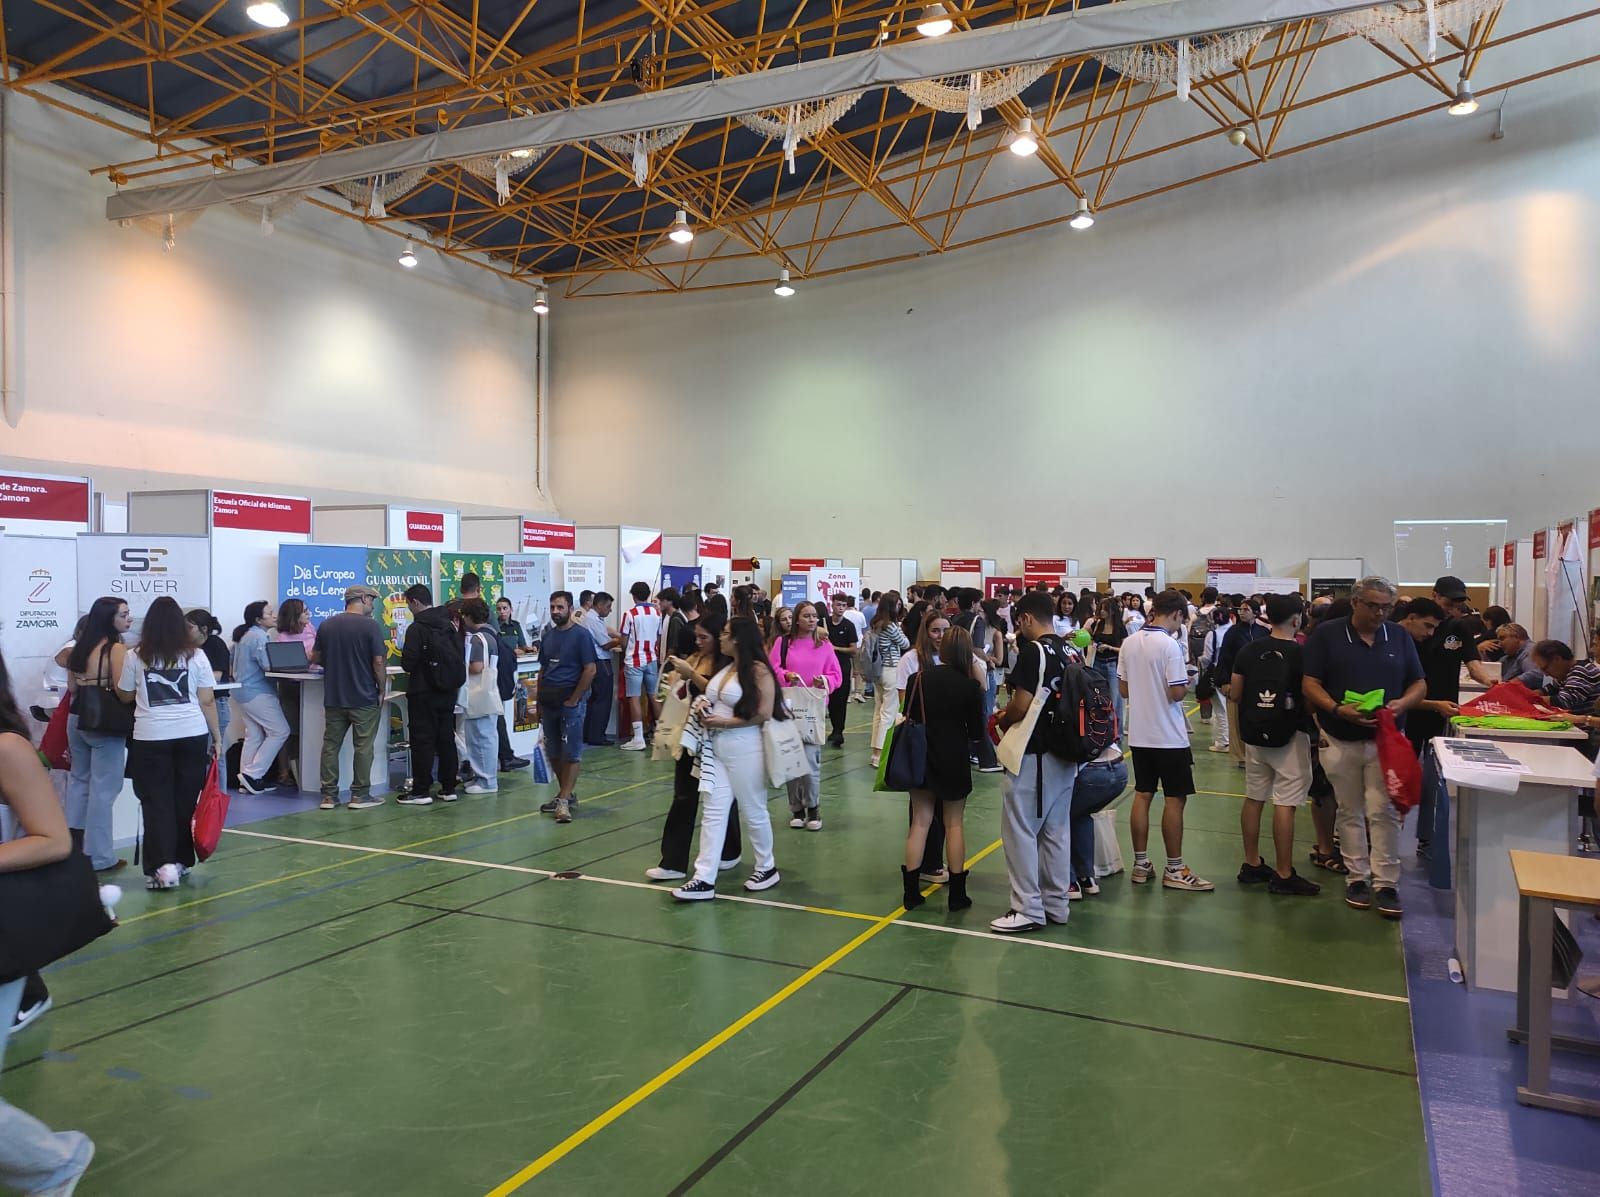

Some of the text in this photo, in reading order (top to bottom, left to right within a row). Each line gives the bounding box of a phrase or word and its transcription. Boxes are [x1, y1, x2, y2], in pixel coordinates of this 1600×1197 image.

[0, 482, 48, 494] de Zamora.
[214, 497, 238, 506] Escuela
[238, 499, 259, 508] Oficial
[214, 506, 239, 515] Zamora
[293, 564, 356, 584] Día Europeo
[366, 575, 430, 585] GUARDIA CIVIL
[833, 581, 853, 589] ANTI
[110, 579, 178, 593] SILVER
[286, 581, 346, 600] de las Leng
[314, 606, 346, 620] Septie
[15, 620, 59, 629] ZAMORA
